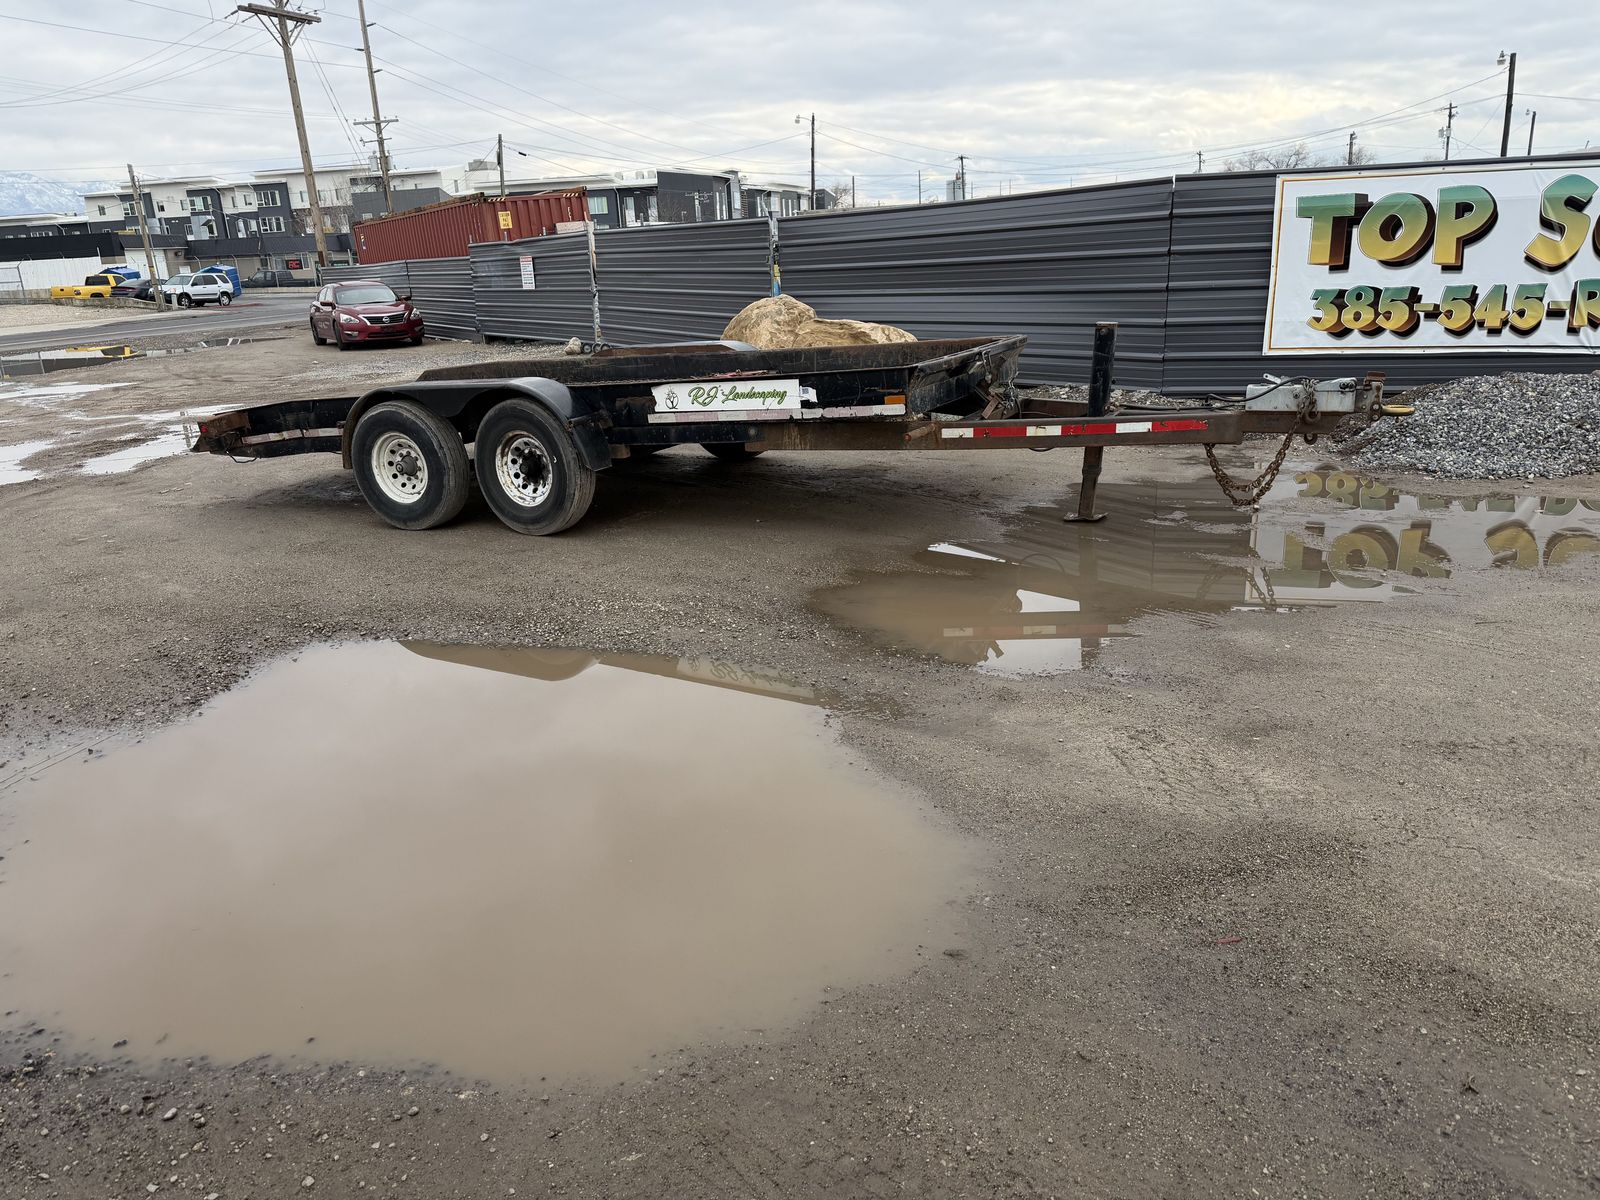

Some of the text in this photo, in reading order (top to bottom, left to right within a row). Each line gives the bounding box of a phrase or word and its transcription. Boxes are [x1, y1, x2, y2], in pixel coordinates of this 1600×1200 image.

[1295, 173, 1600, 272] TOP S
[721, 385, 788, 405] Landscaping
